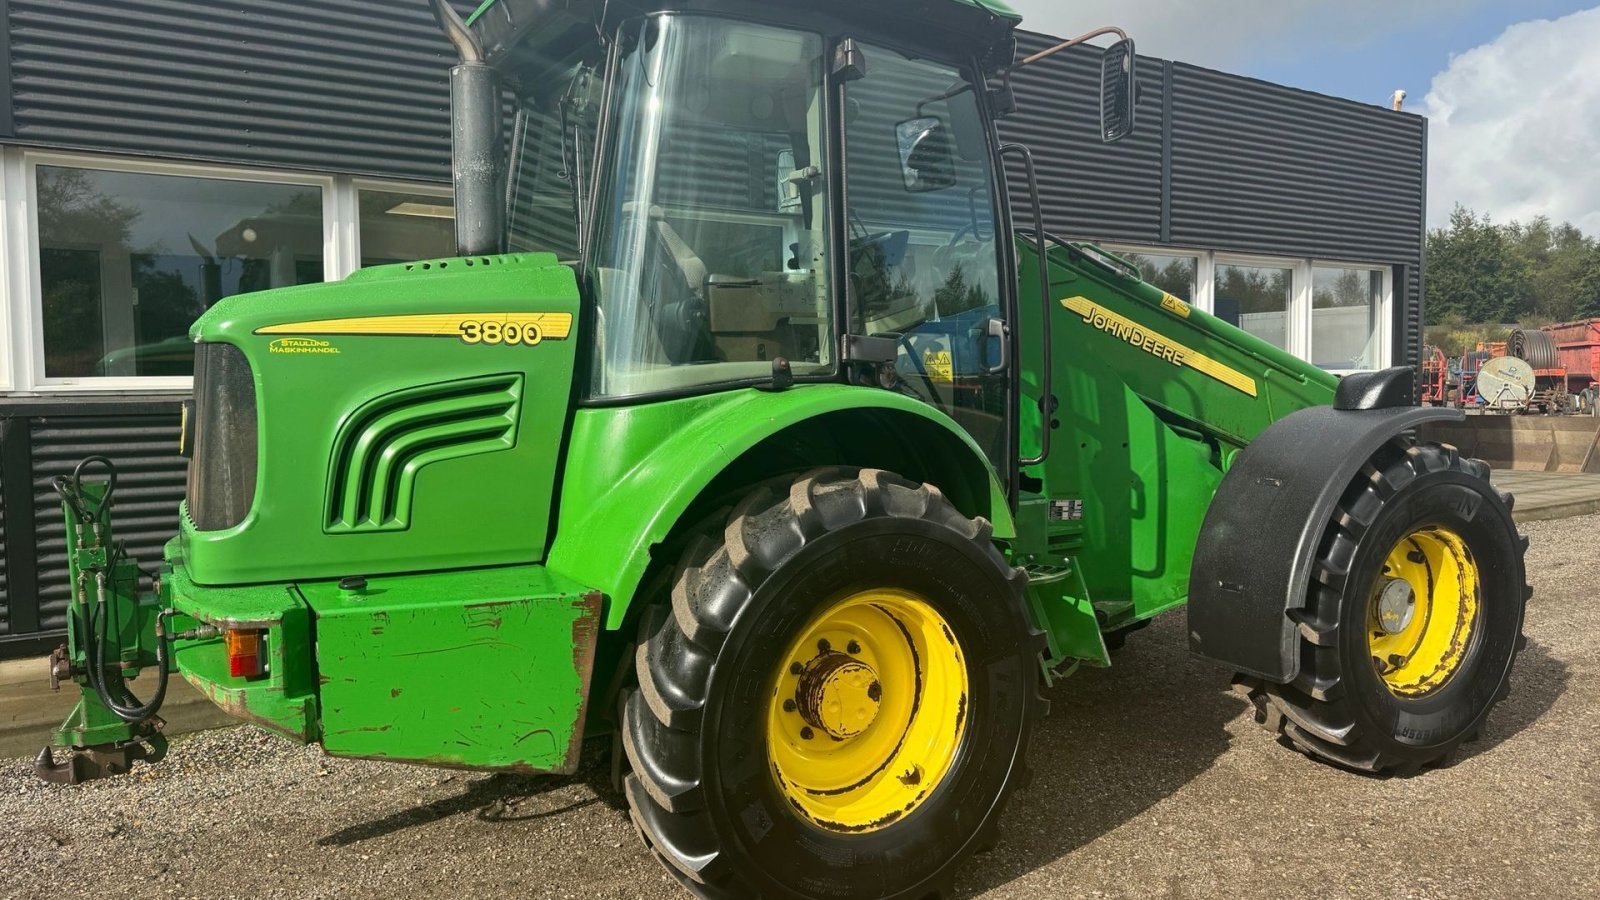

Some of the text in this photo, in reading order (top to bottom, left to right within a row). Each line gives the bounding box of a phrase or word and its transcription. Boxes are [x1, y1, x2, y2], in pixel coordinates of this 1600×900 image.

[280, 339, 330, 347] STAULUND
[459, 320, 543, 347] 3800
[1083, 307, 1184, 366] JOHN DEERE
